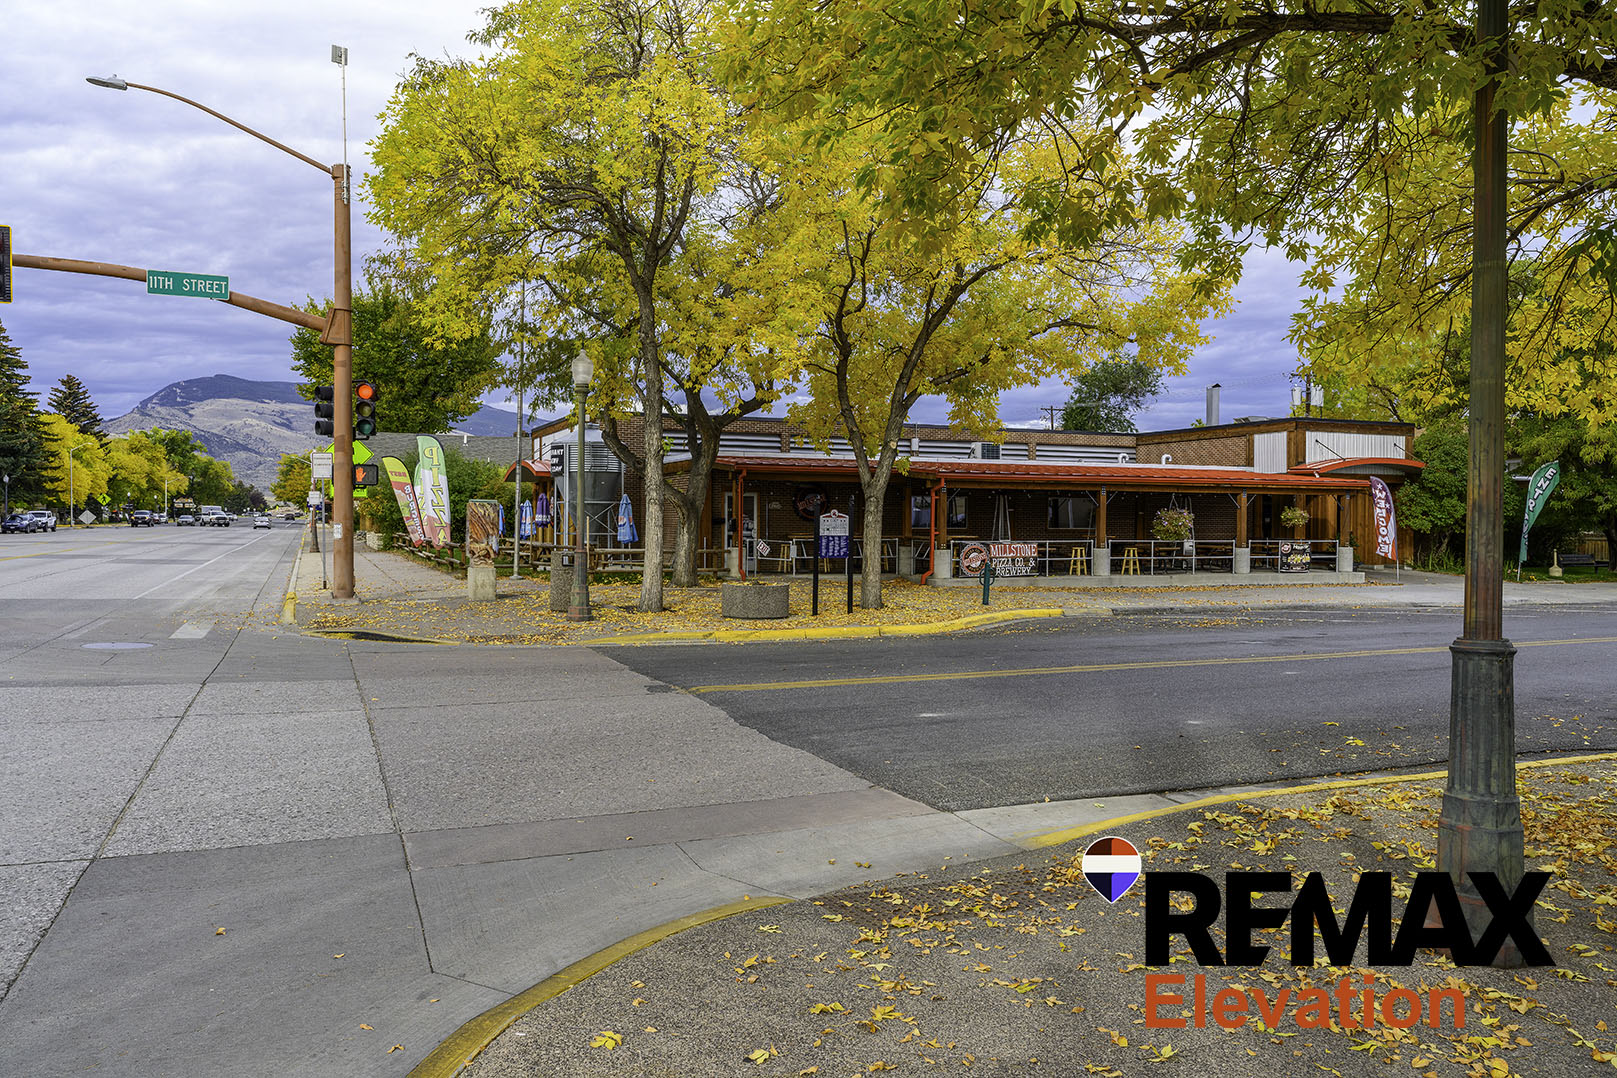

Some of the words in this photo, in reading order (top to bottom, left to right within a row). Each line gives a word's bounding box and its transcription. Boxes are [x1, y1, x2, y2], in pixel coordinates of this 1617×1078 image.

[149, 276, 173, 290] 11TH
[182, 279, 227, 294] STREET
[990, 544, 1037, 557] MILLSTONE
[992, 558, 1011, 568] PIZZA
[1016, 557, 1025, 567] CO.
[1029, 557, 1036, 567] &
[995, 566, 1031, 576] BREWERY
